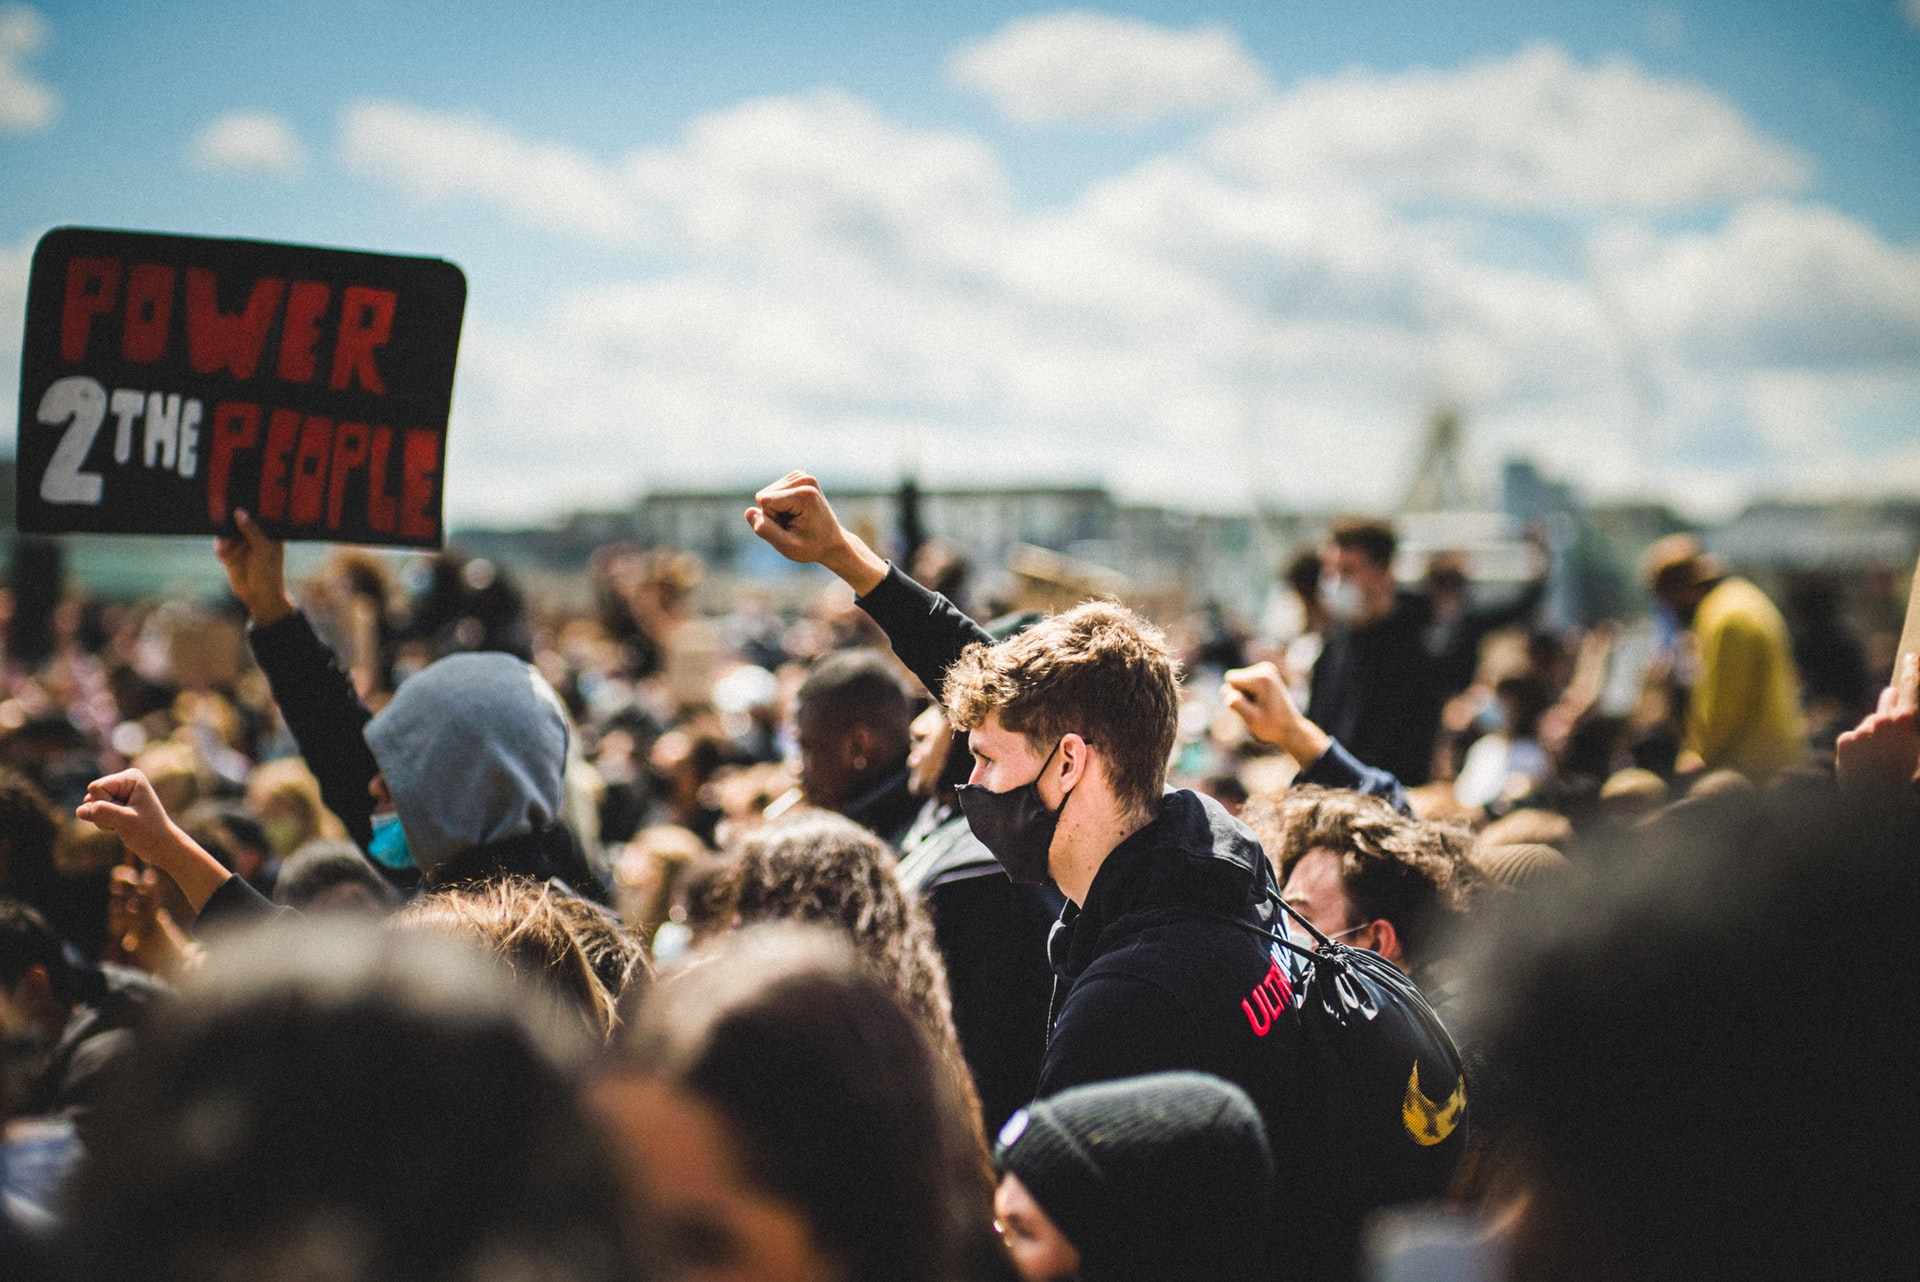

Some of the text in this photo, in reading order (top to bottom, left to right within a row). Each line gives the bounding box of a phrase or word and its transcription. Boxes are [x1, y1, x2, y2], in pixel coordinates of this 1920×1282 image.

[61, 254, 398, 395] POWER
[36, 375, 439, 538] 2 THE PEOPLE
